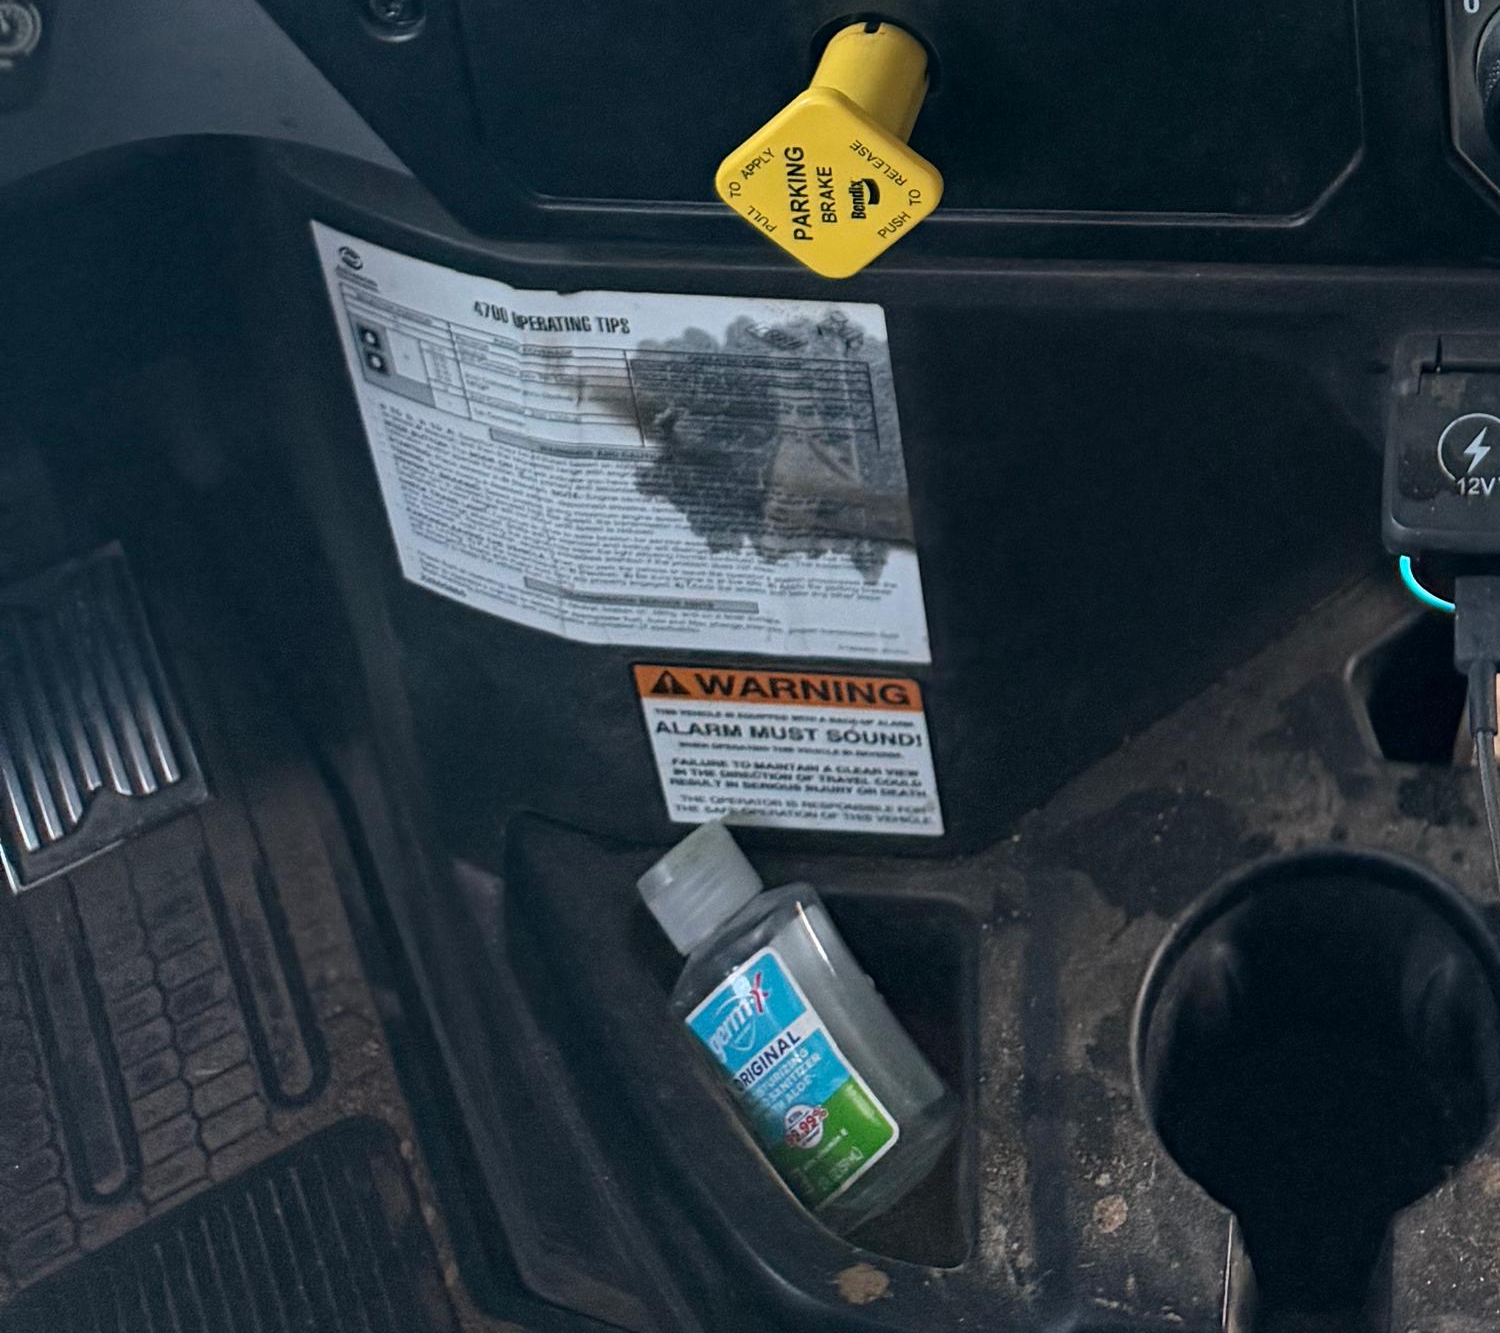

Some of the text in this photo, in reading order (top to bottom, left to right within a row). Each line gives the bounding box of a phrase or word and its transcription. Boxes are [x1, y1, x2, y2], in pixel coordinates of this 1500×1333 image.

[729, 147, 778, 233] PULL TO APPLY
[784, 146, 814, 240] PARKING
[816, 166, 838, 223] BRAKE
[849, 140, 921, 239] PUSH TO RELEASE
[849, 179, 867, 219] Bendix
[596, 316, 631, 334] TIPS
[1457, 477, 1496, 496] 12V
[694, 673, 910, 706] WARNING
[656, 721, 923, 747] ALARM MUST SOUND!
